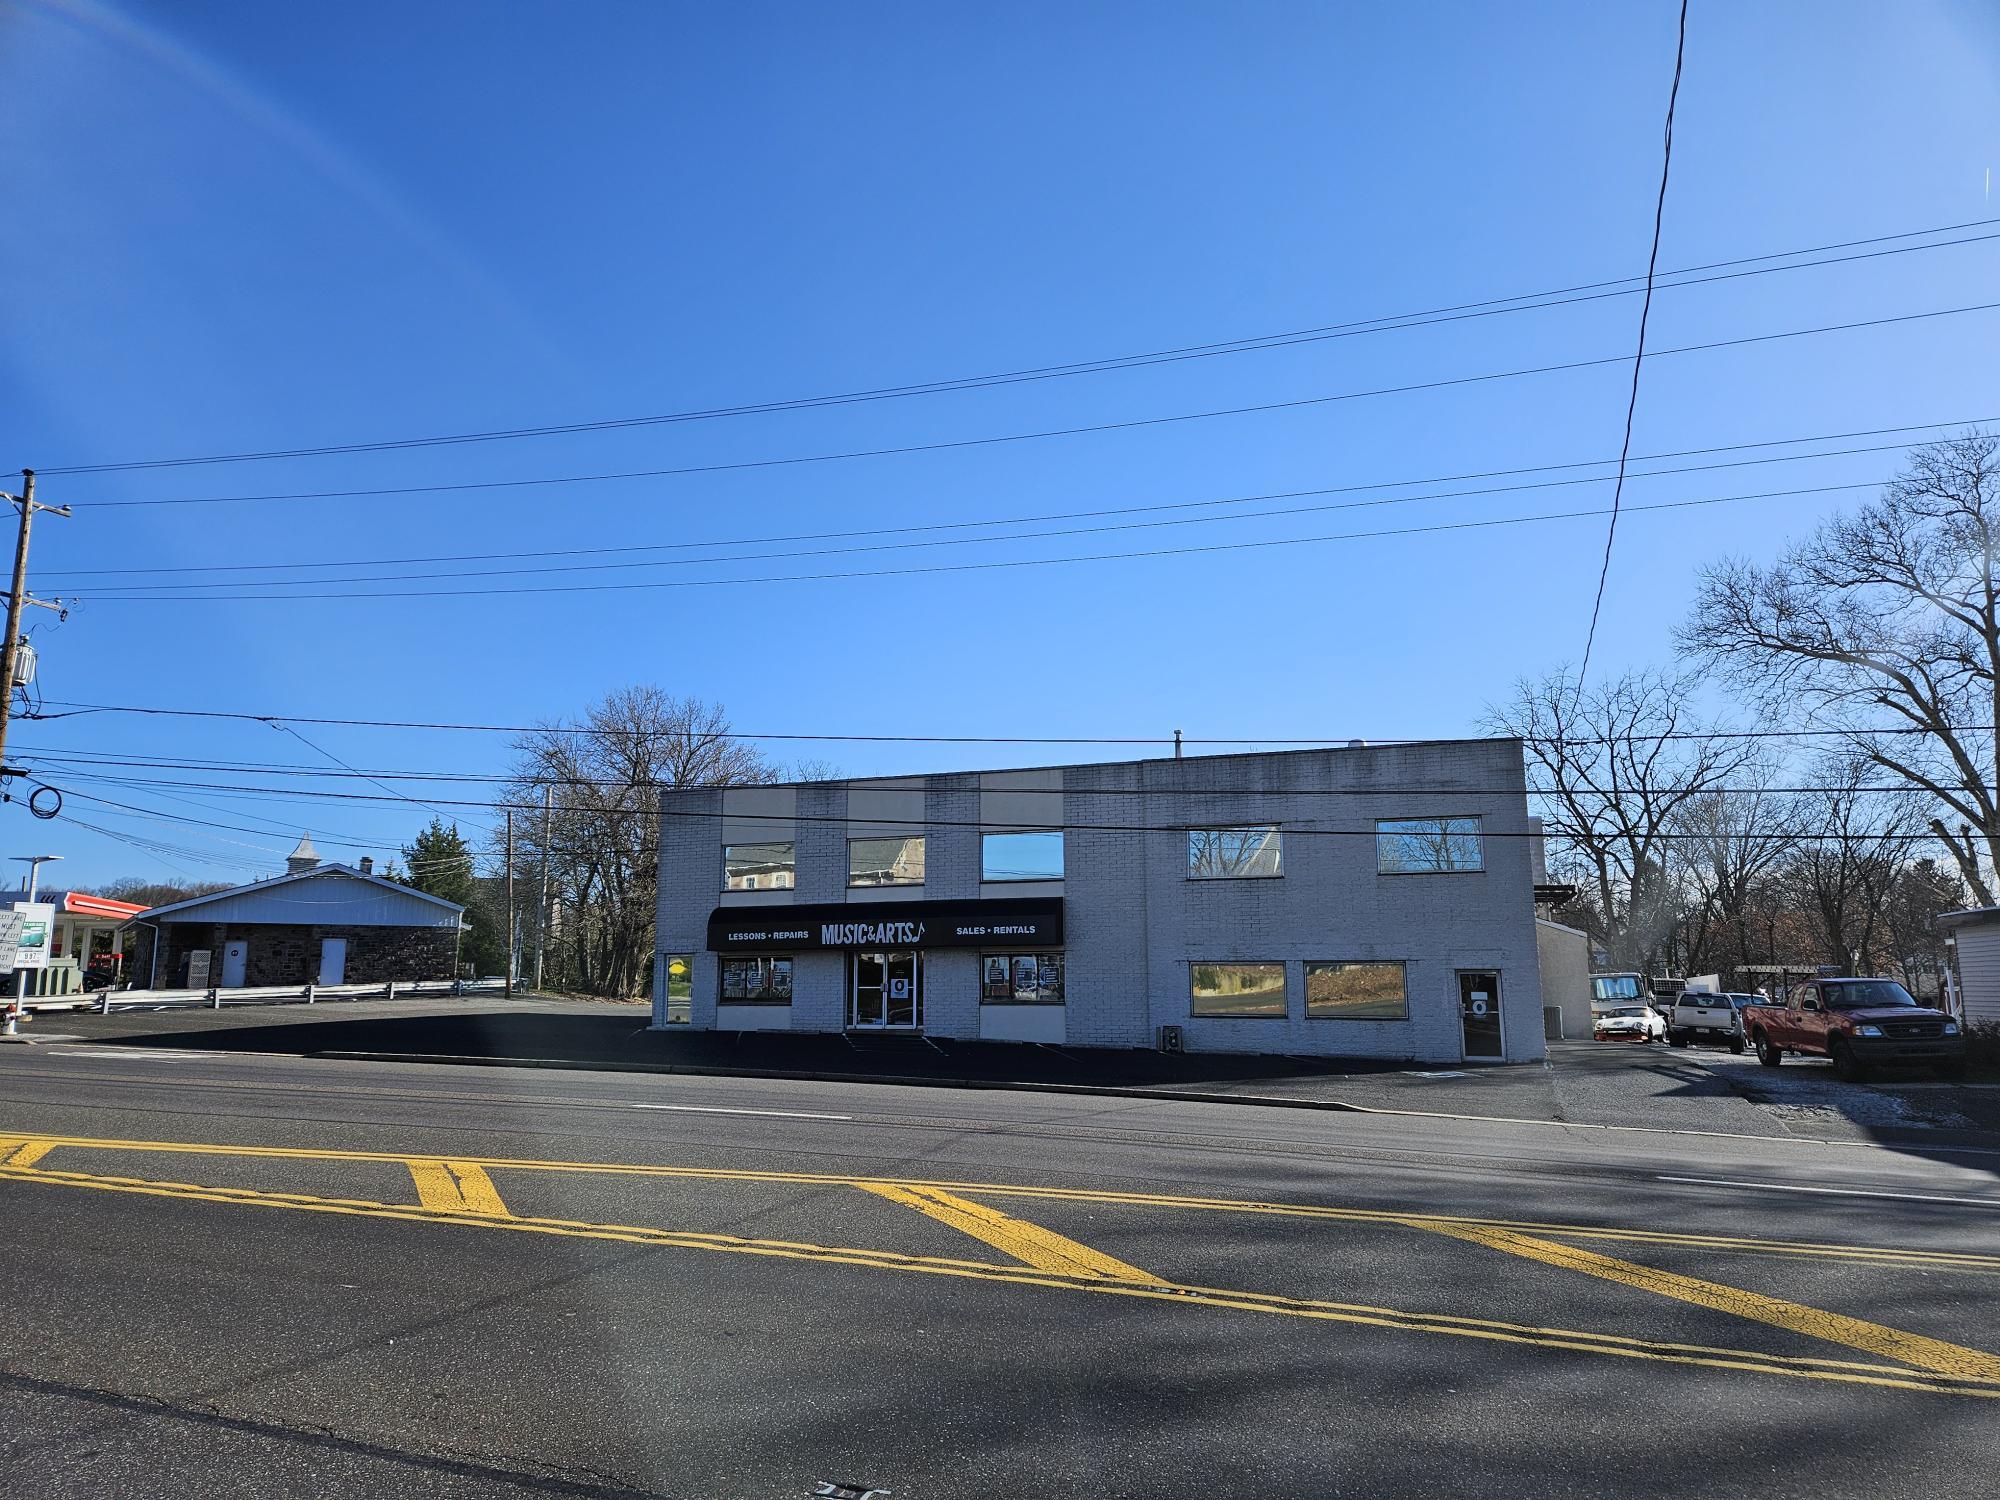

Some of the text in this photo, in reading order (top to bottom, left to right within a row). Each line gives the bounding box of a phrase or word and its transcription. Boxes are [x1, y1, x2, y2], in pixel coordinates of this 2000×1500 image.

[956, 925, 1036, 935] SALES RENTALS
[728, 931, 809, 941] LESSONS REPAIRS
